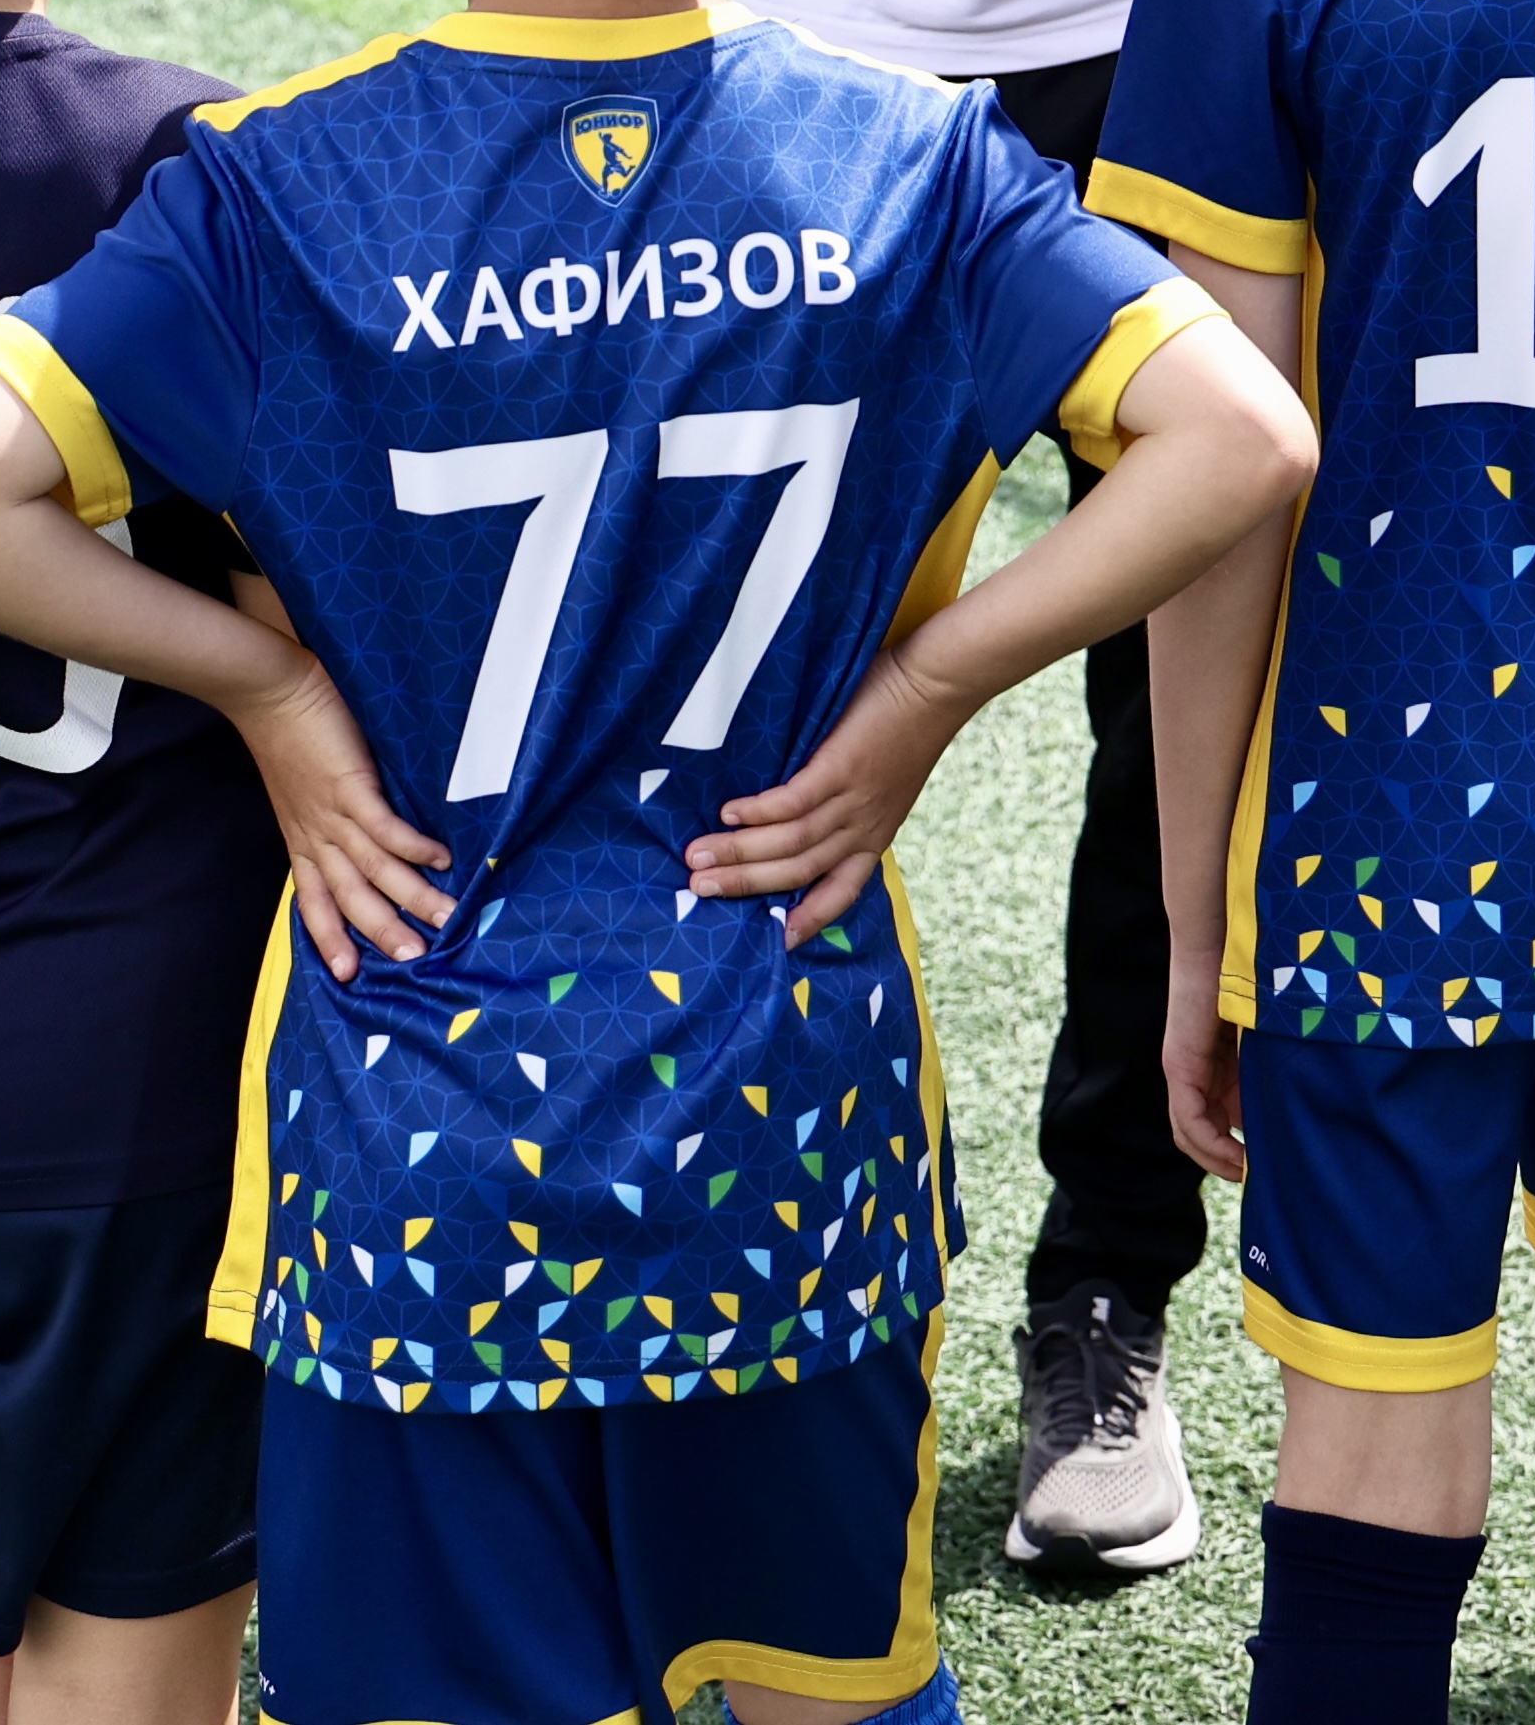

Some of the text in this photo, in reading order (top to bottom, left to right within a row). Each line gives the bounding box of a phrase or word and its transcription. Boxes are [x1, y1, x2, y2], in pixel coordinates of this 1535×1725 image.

[575, 114, 645, 137] ЮНИОР
[391, 228, 857, 352] ХАФИЗОВ
[388, 397, 860, 802] 77
